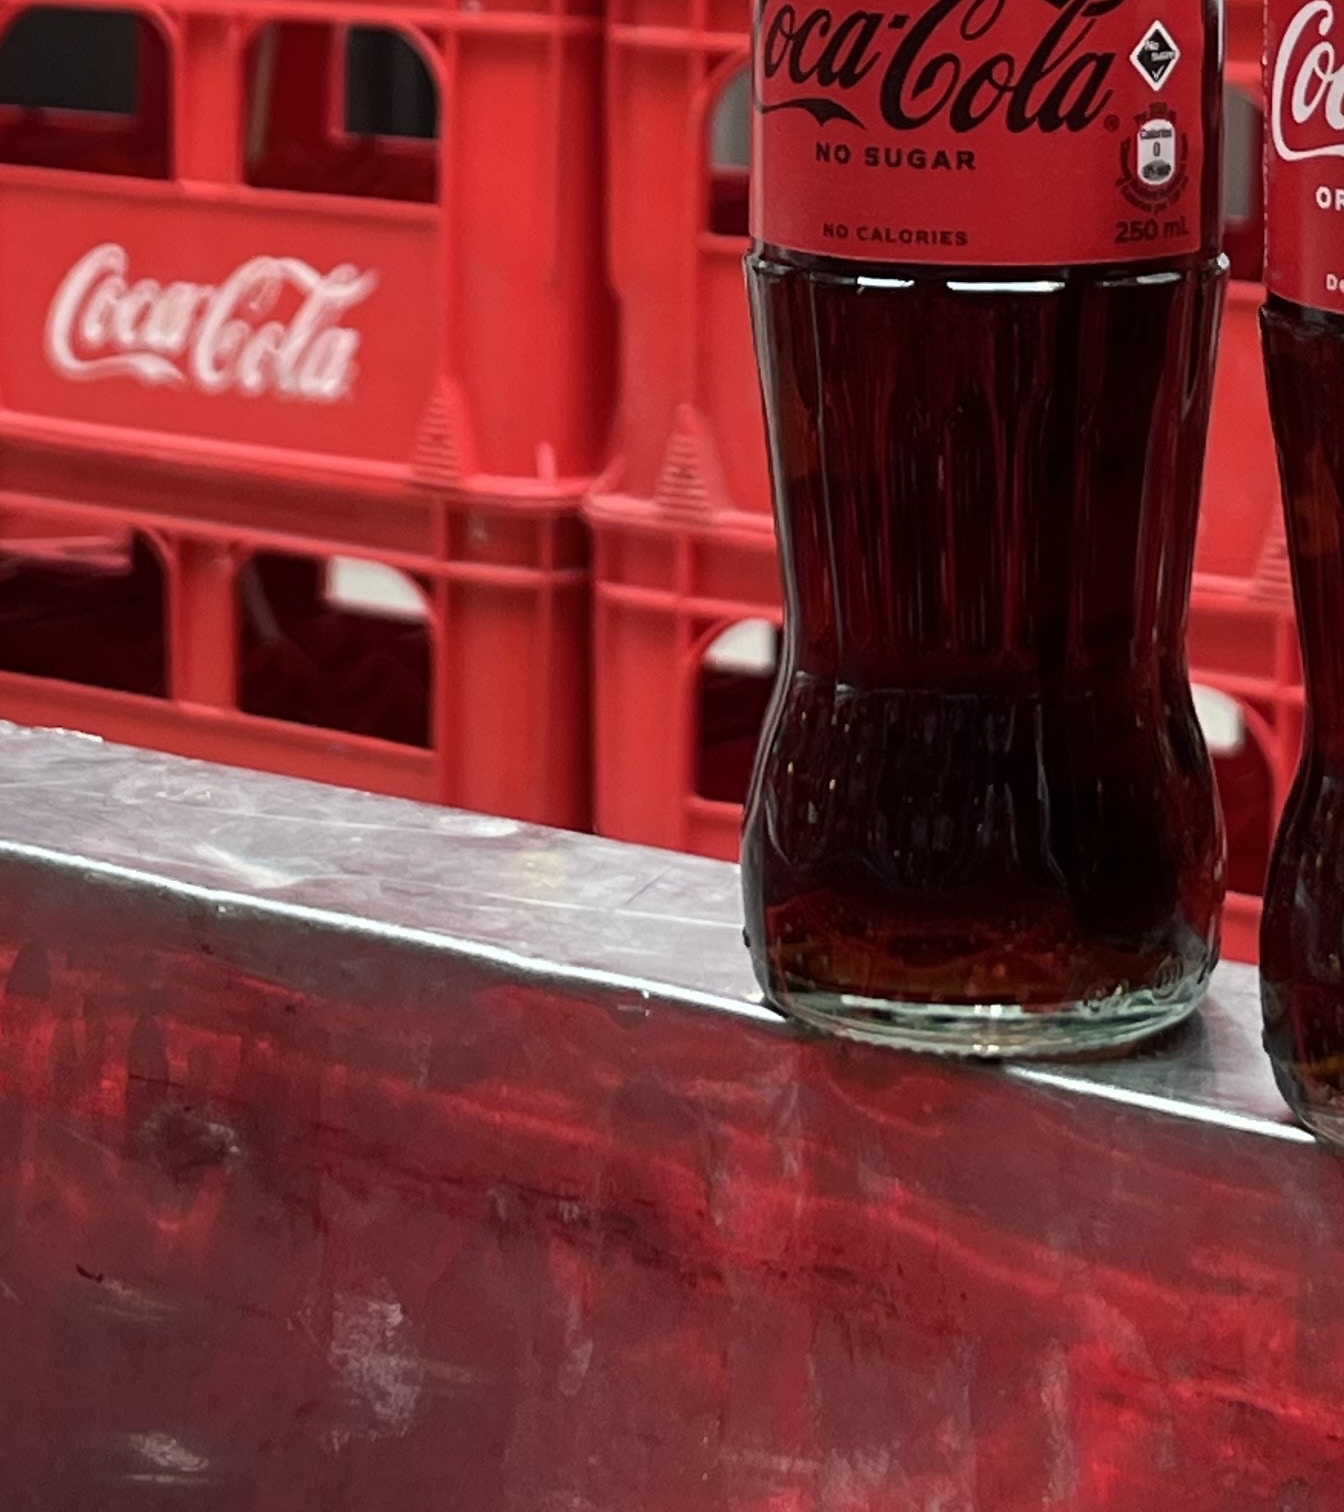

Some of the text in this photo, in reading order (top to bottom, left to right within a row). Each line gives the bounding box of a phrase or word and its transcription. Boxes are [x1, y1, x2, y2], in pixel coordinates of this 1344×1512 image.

[815, 142, 977, 171] NO SUGAR
[823, 224, 968, 247] NO CALORIES
[1115, 221, 1158, 245] 250
[46, 242, 378, 402] Coca-Cola
